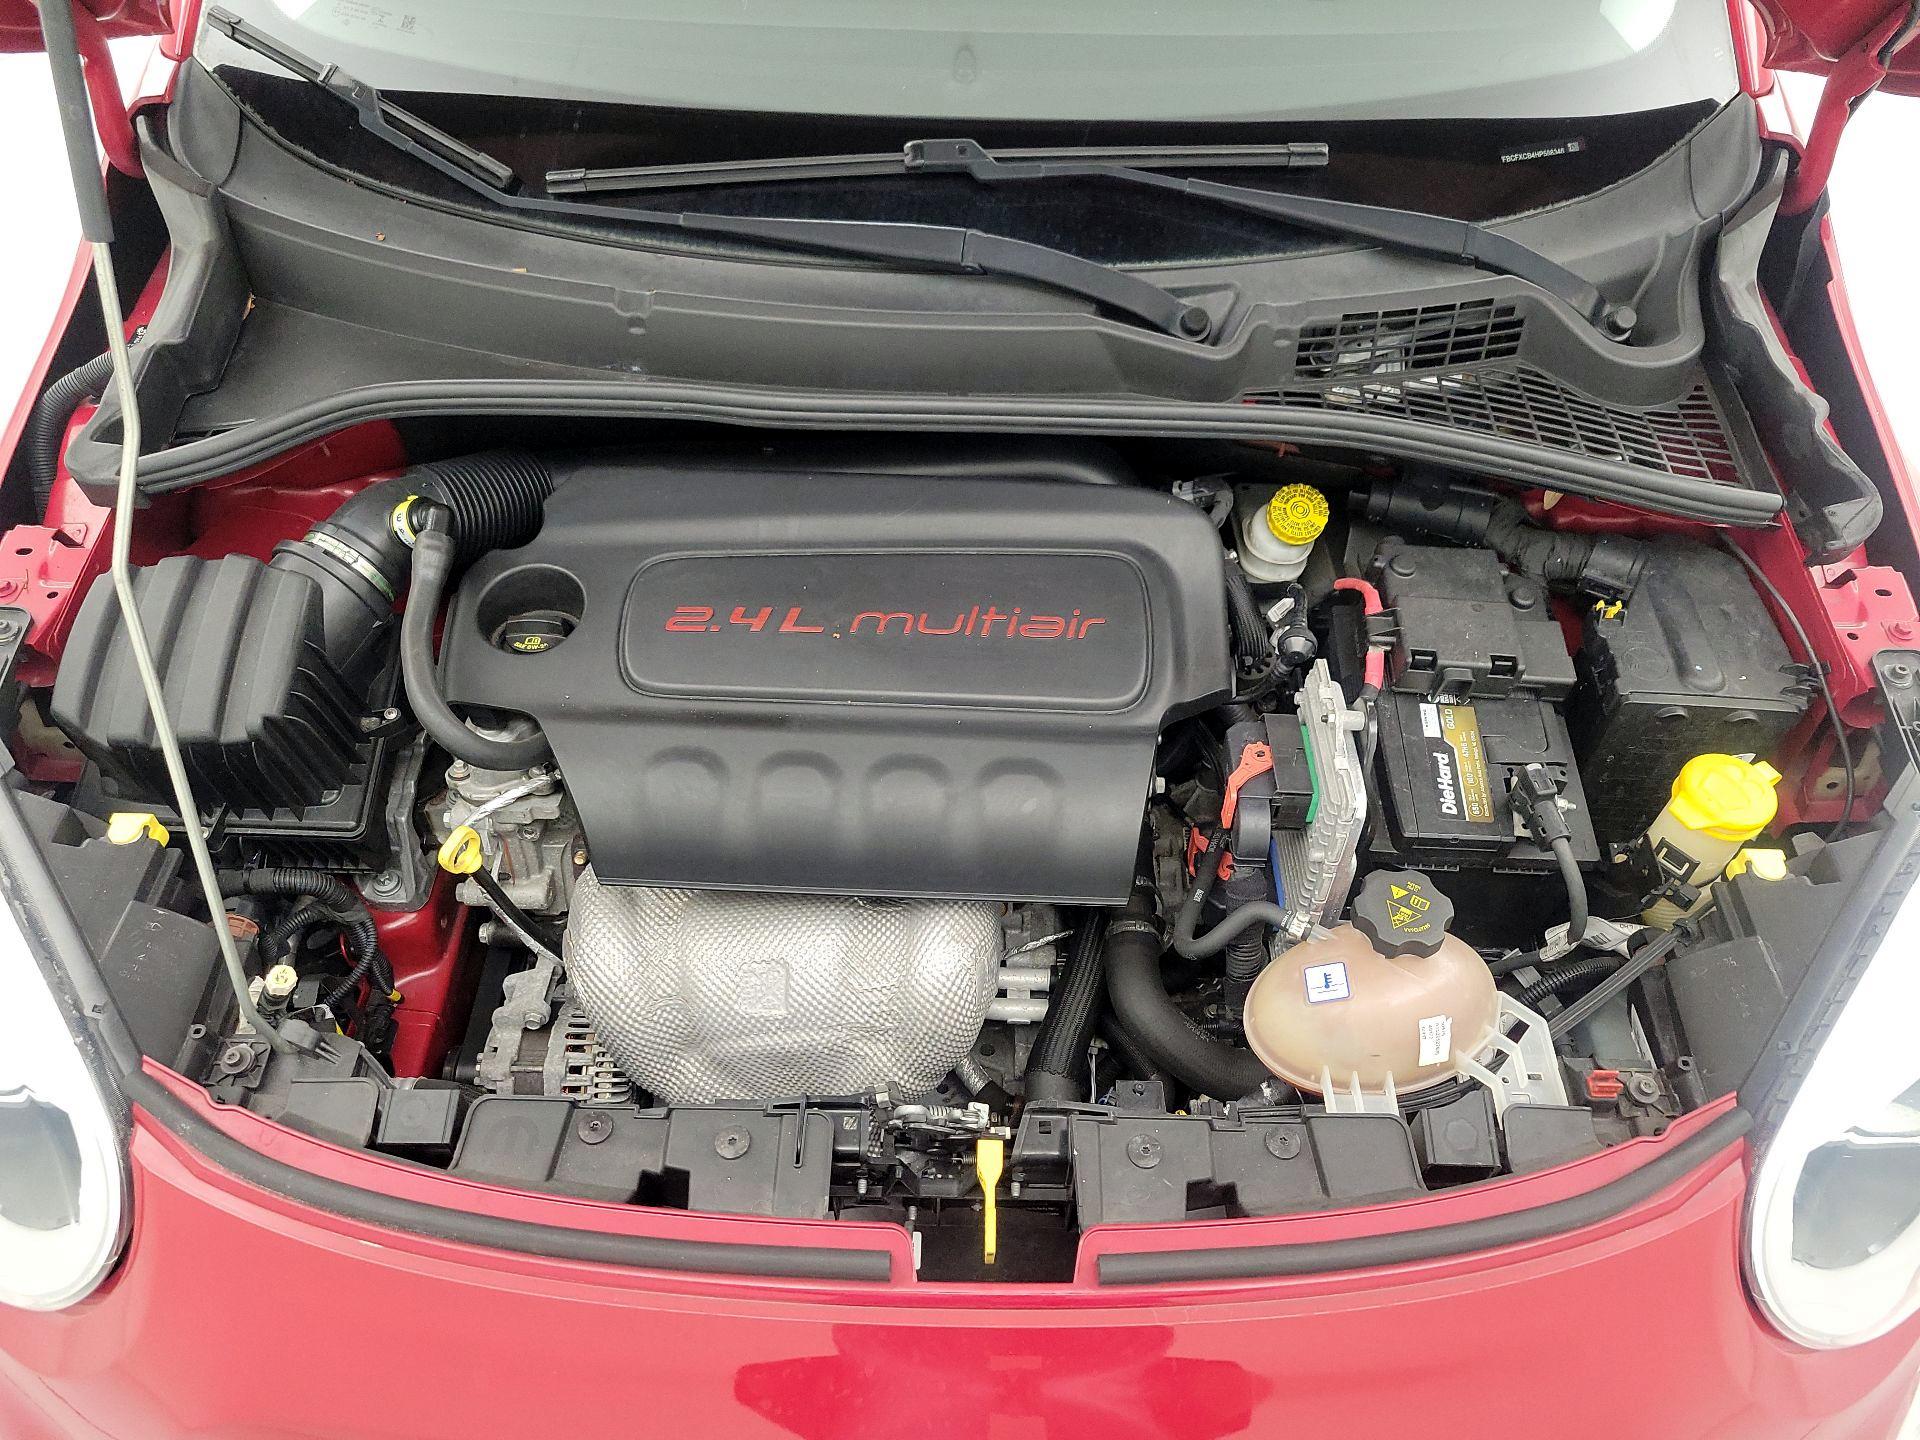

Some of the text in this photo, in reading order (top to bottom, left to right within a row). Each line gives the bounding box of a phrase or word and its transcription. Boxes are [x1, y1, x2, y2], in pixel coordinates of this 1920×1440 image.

[850, 605, 1106, 639] multiair
[1444, 709, 1456, 730] GOLD
[1432, 752, 1458, 815] DieHard
[1472, 802, 1480, 815] 650
